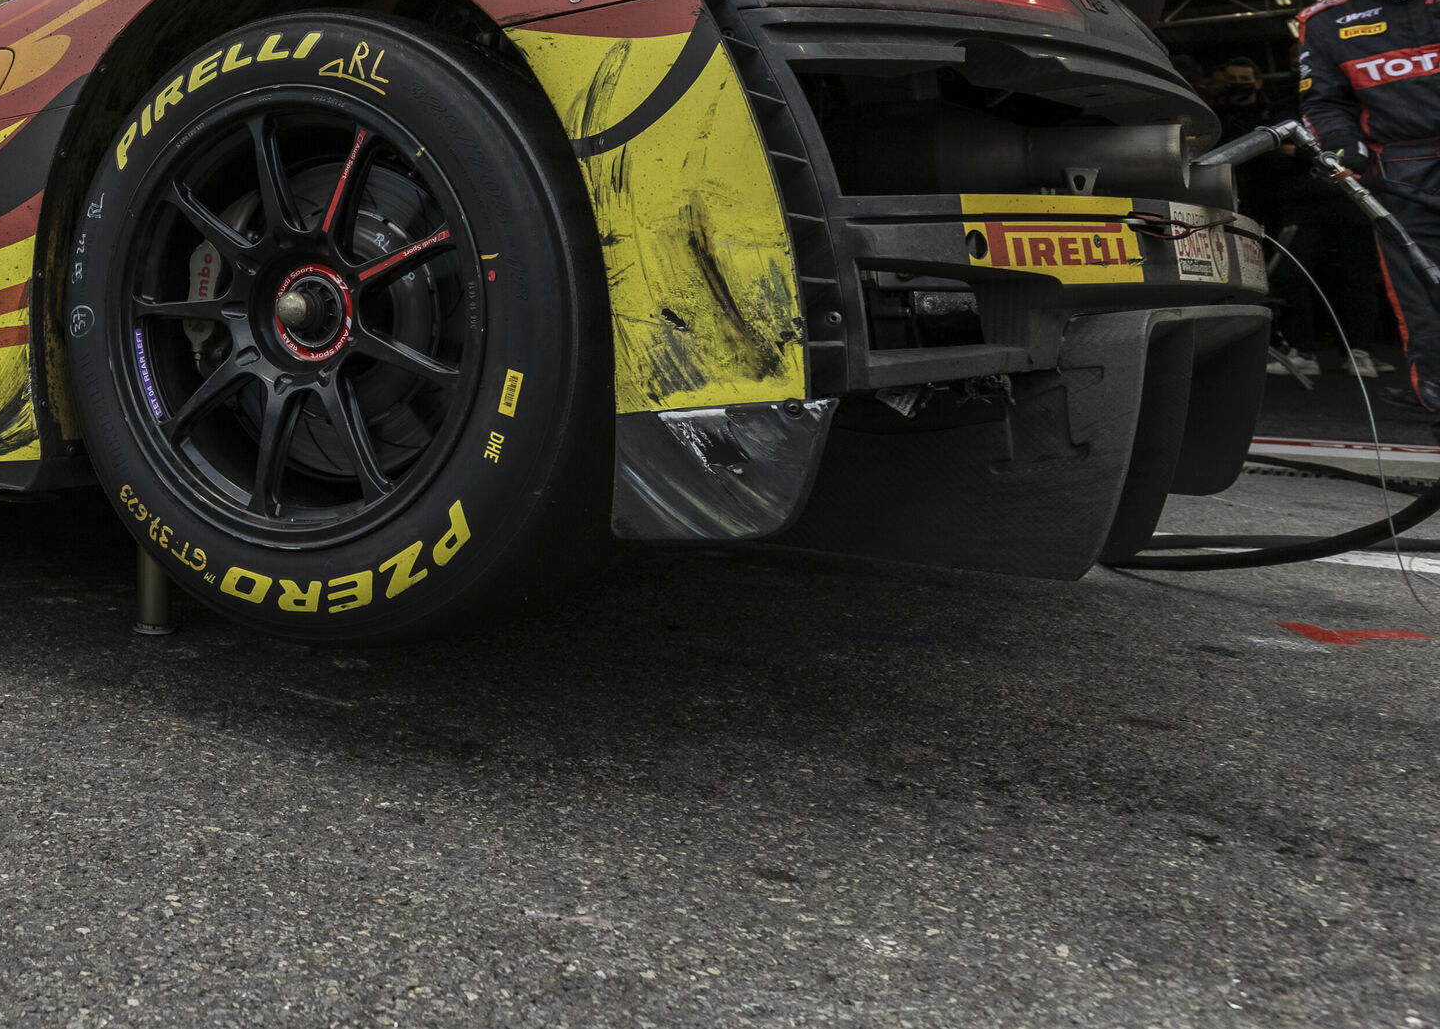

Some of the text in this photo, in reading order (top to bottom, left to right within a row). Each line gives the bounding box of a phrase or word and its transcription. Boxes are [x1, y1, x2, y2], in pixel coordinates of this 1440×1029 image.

[348, 41, 389, 84] RL
[116, 32, 322, 170] PIRELLI
[342, 143, 361, 179] Audi Sport
[985, 213, 1127, 267] PIRELLI
[290, 266, 314, 279] Sport
[332, 274, 348, 290] 37
[72, 308, 87, 333] 37
[135, 332, 144, 354] LEFT
[138, 356, 150, 382] REAR
[484, 431, 505, 464] DHE
